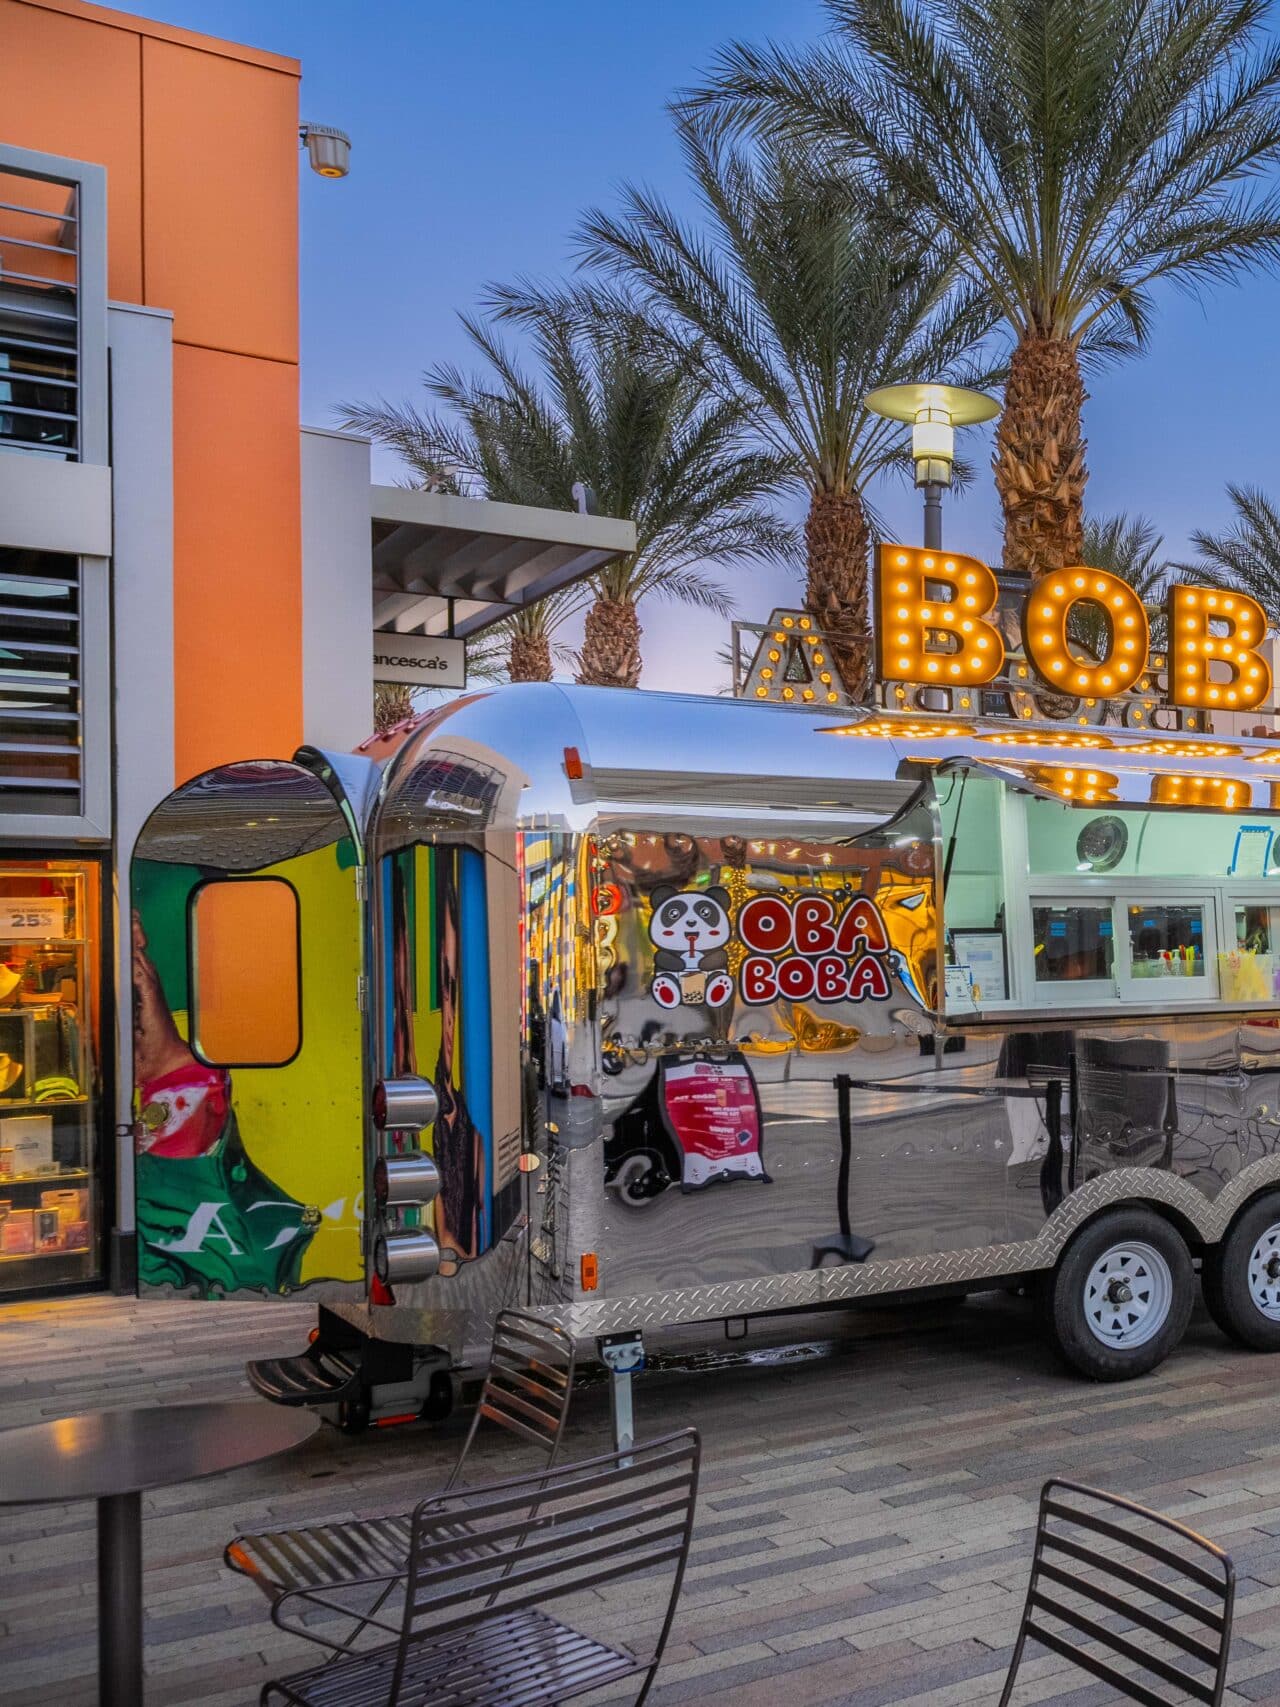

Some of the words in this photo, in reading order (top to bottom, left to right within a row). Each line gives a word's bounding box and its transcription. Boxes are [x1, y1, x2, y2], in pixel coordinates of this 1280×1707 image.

[373, 654, 448, 670] ancesca's
[738, 896, 889, 956] OBA
[741, 955, 890, 1003] BOBA
